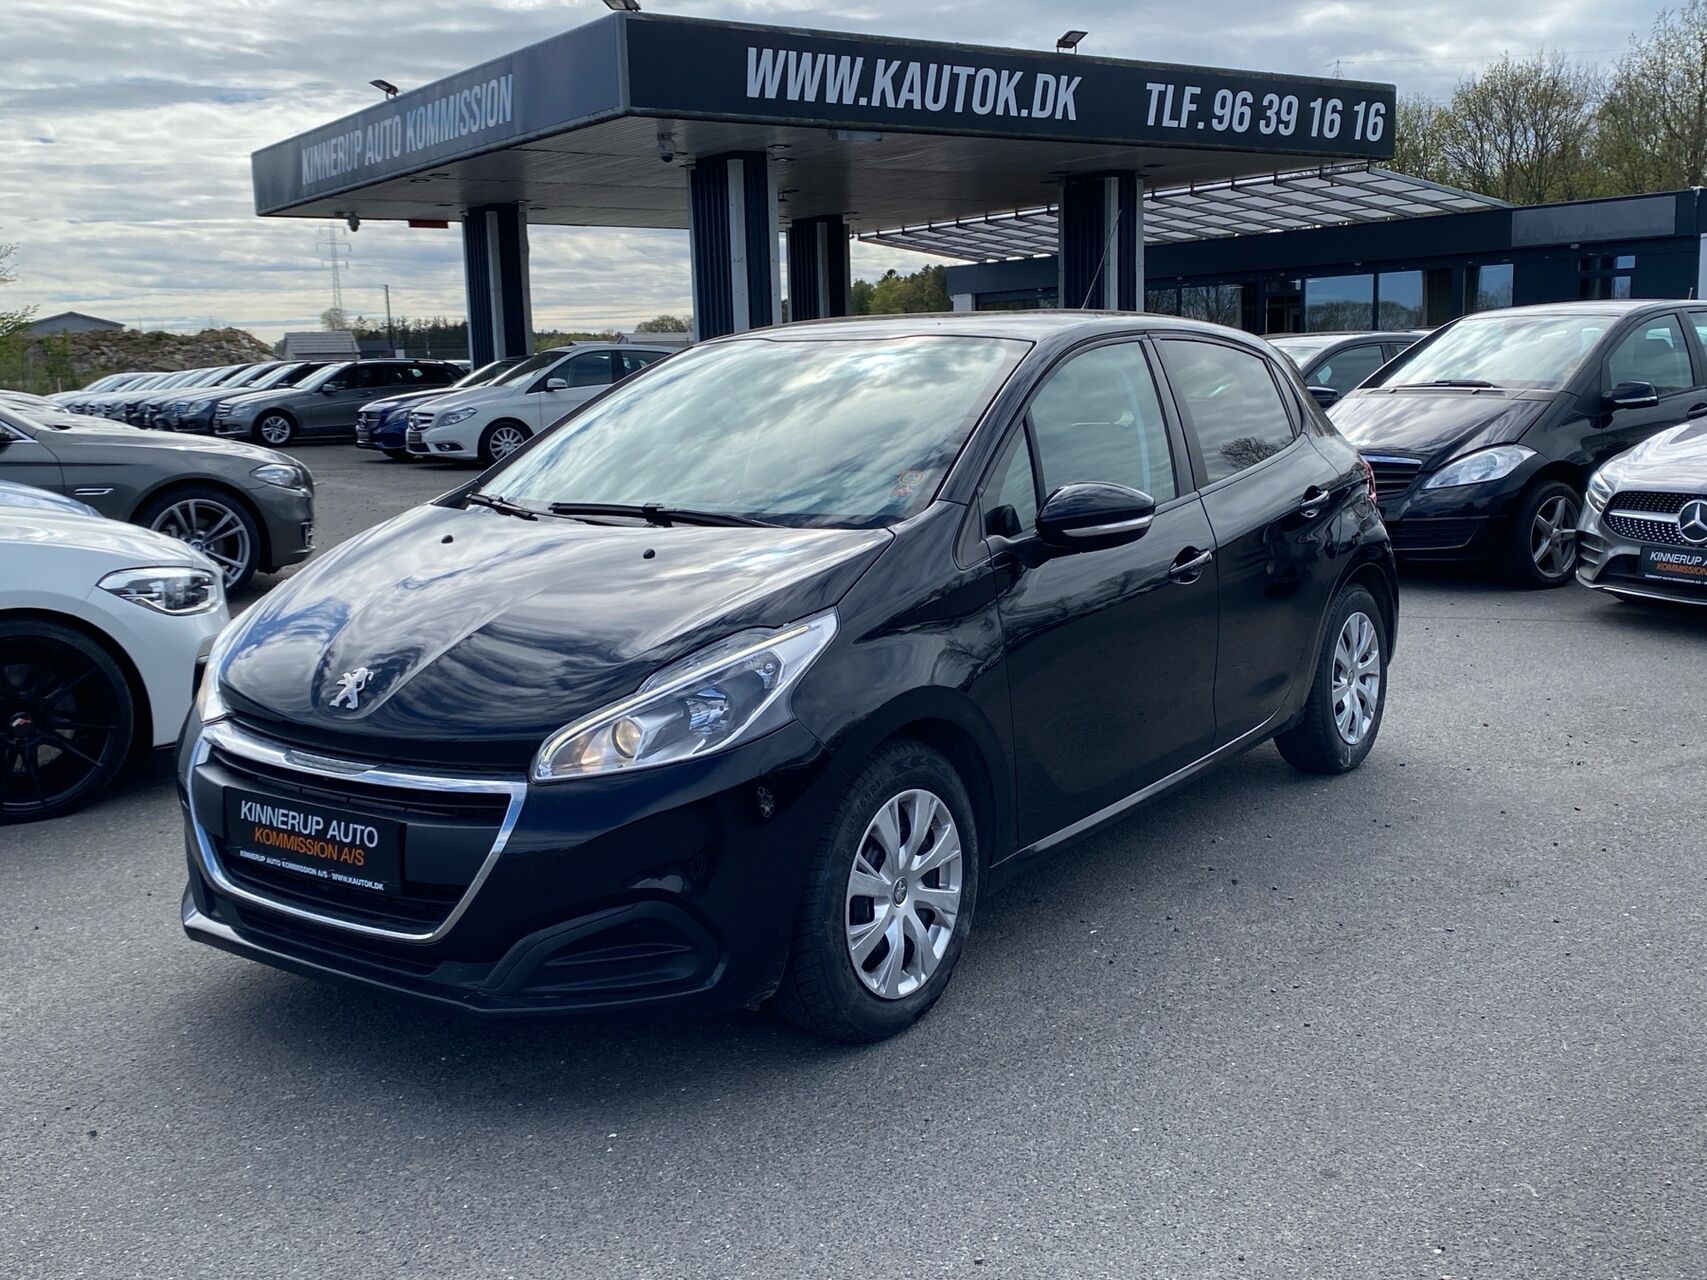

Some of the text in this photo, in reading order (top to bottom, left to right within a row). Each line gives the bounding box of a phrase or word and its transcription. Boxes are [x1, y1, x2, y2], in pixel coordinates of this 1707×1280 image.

[746, 47, 1082, 121] WWW.KAUTOK.DK
[302, 74, 513, 185] KINNERUP AUTO KOMMISSION
[1146, 82, 1386, 142] TLF. 96 39 16 16
[1650, 551, 1702, 566] KINNERUP
[240, 800, 379, 848] KINNERUP AUTO
[254, 827, 365, 866] KOMMISSION A/S
[266, 857, 281, 867] AUTO
